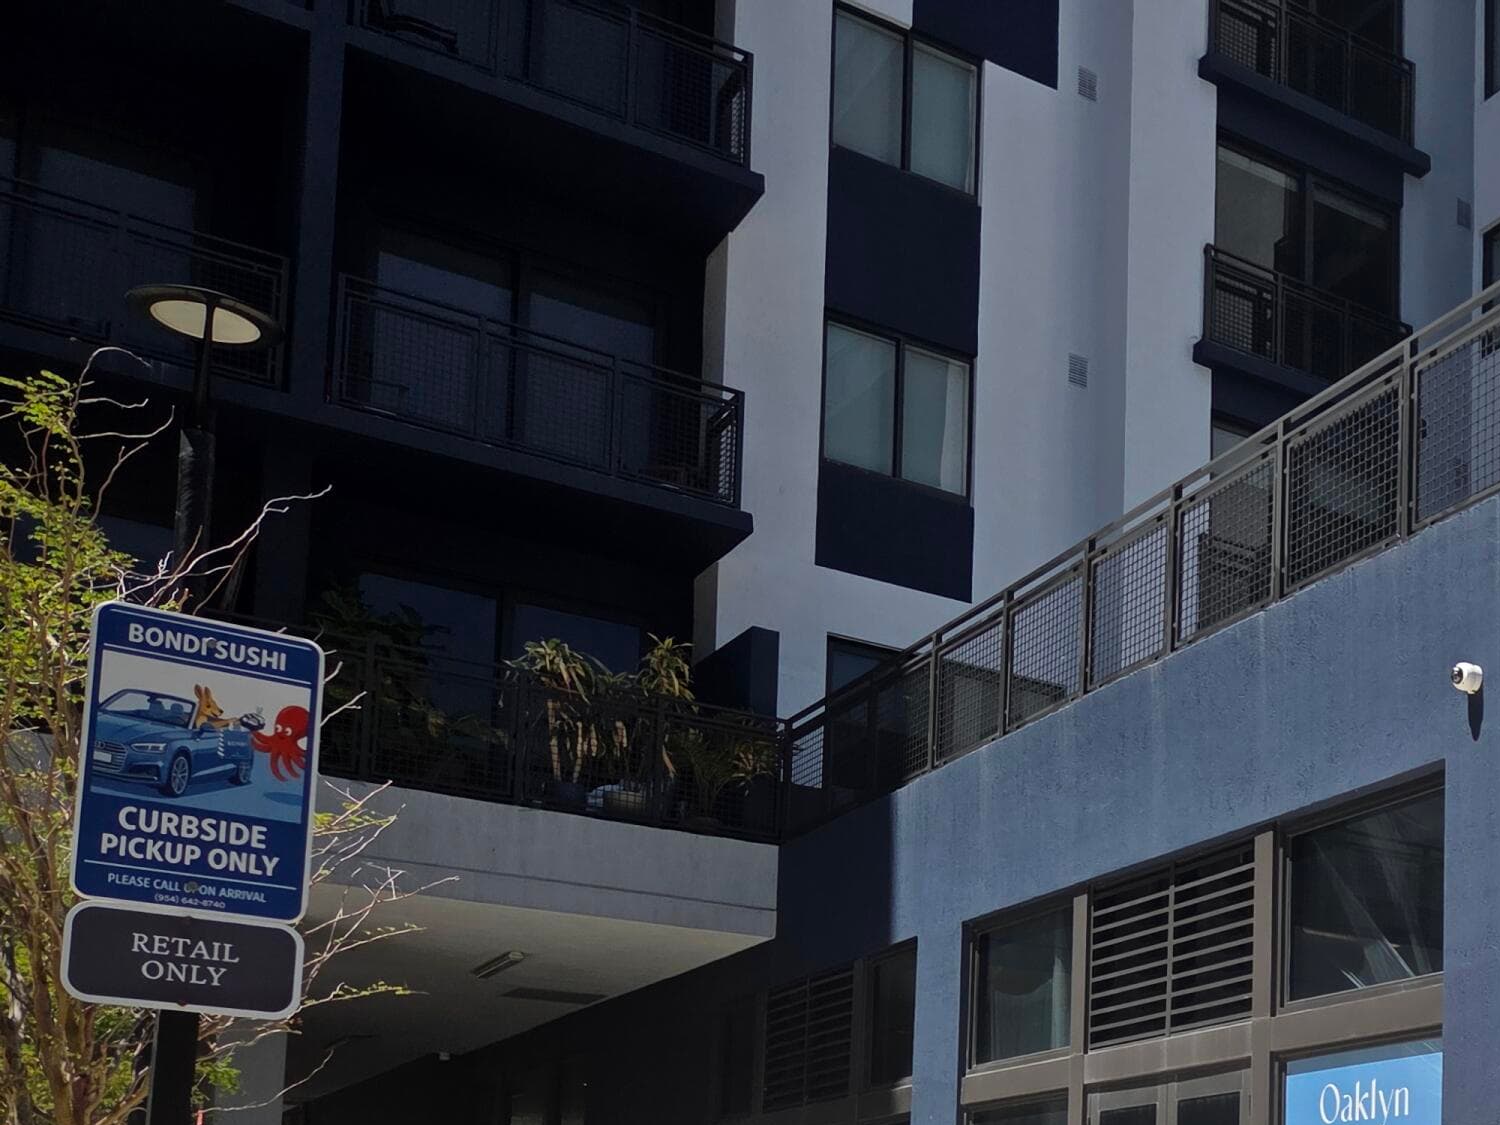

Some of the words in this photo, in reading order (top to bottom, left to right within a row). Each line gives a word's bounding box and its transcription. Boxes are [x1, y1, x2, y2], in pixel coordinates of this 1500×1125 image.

[128, 623, 209, 656] BONDI
[215, 639, 287, 672] SUSHI
[118, 806, 267, 850] CURBSIDE
[101, 833, 201, 866] PICKUP
[207, 848, 280, 877] ONLY
[107, 873, 151, 889] PLEASE
[153, 879, 181, 892] CALL
[218, 887, 267, 903] ARRIVAL
[131, 933, 240, 964] RETAIL
[141, 960, 227, 987] ONLY
